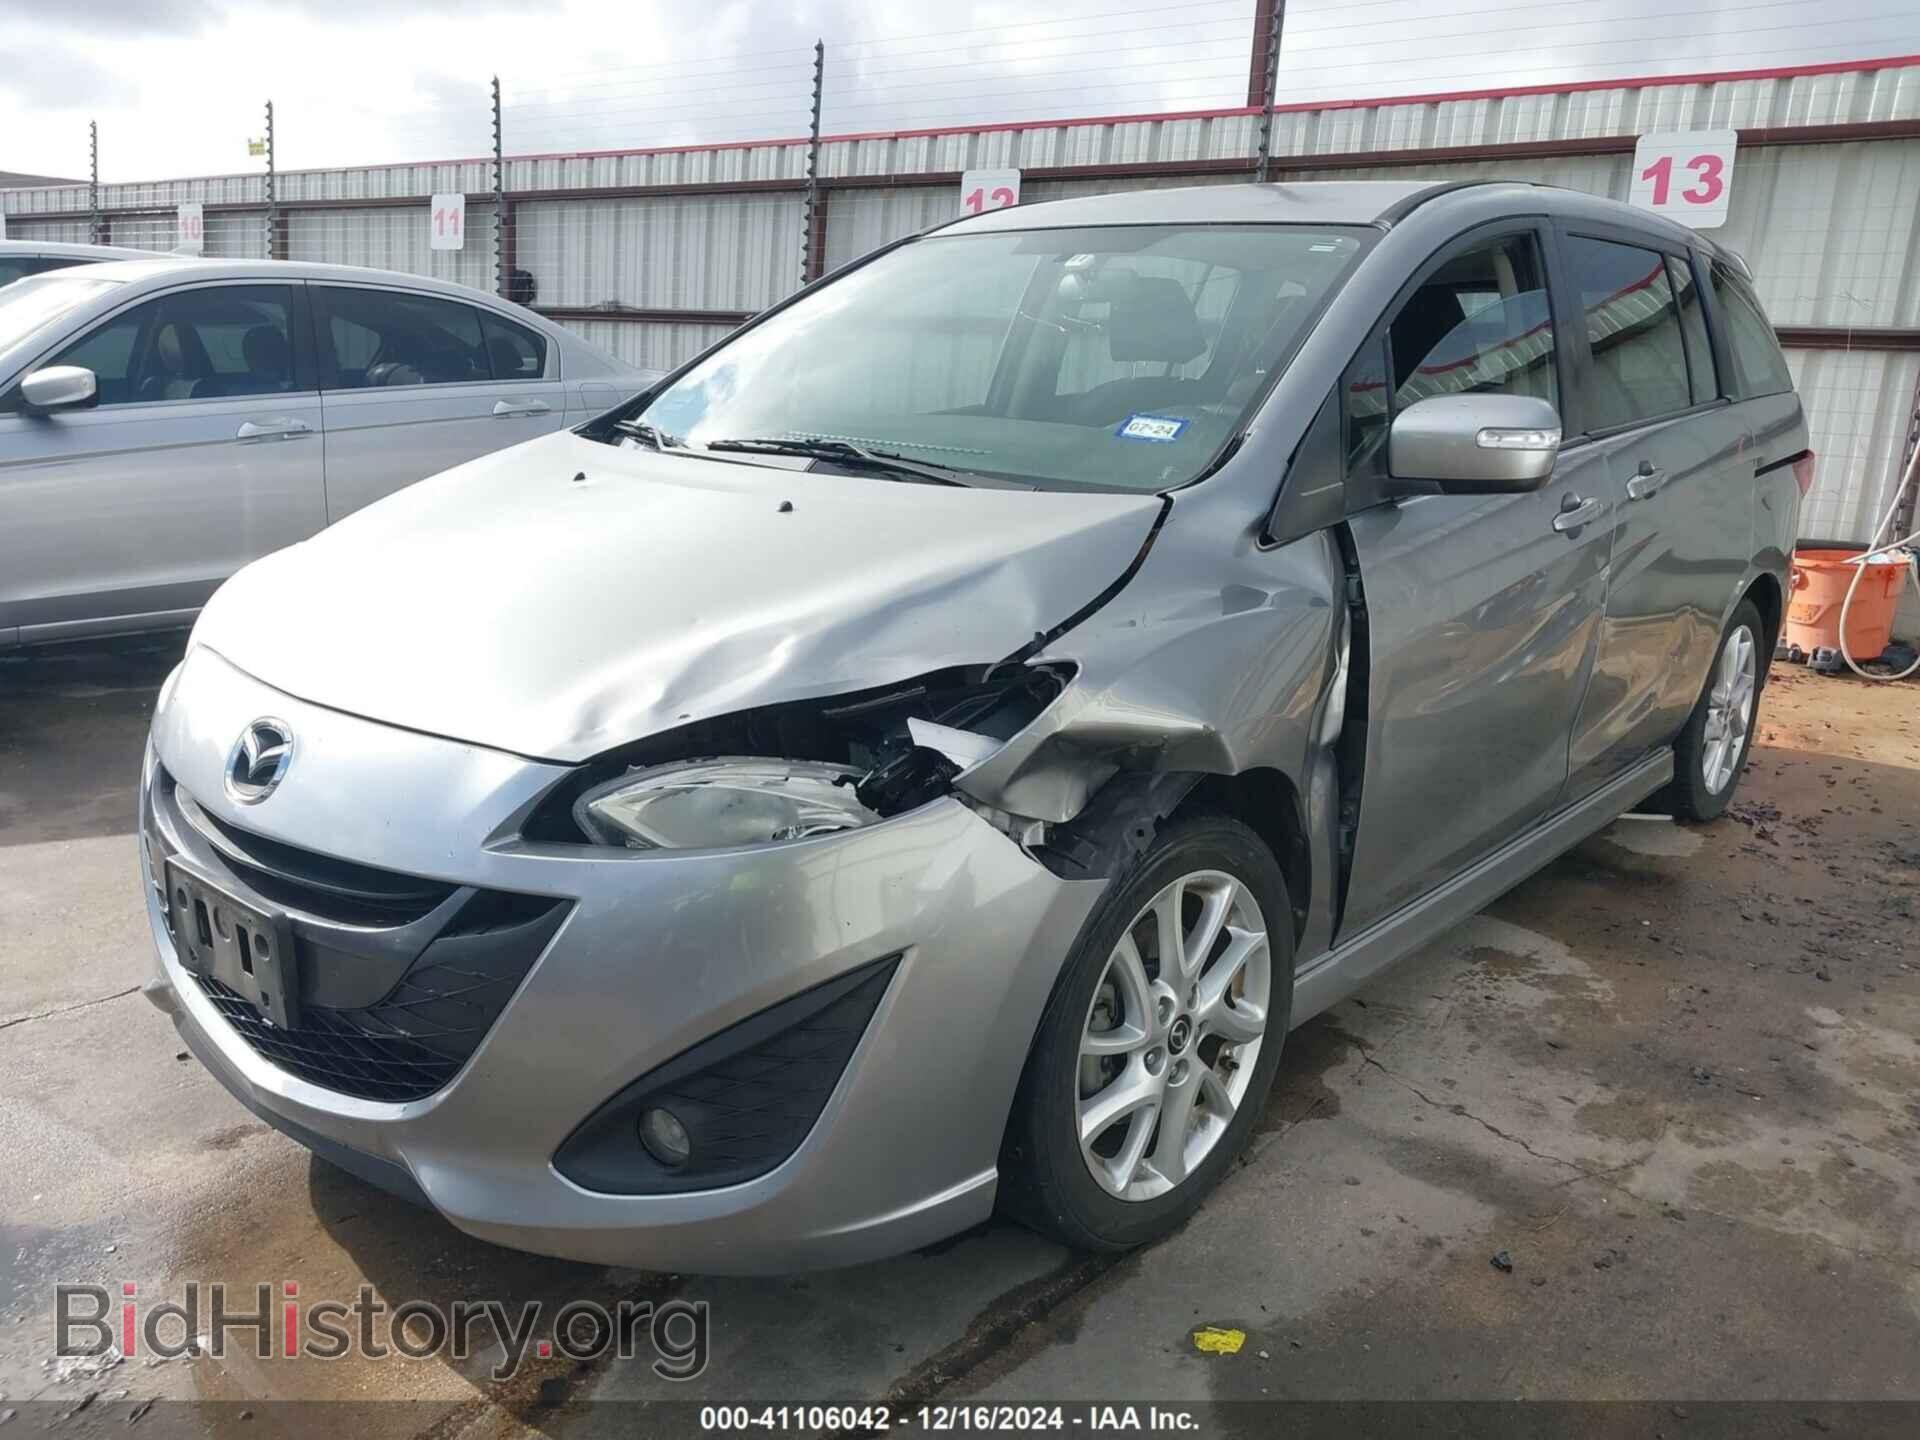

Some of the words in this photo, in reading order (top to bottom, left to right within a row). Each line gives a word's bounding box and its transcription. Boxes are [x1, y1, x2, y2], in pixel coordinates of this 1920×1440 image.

[1641, 154, 1724, 205] 13
[181, 215, 201, 240] 10
[433, 207, 460, 236] 11
